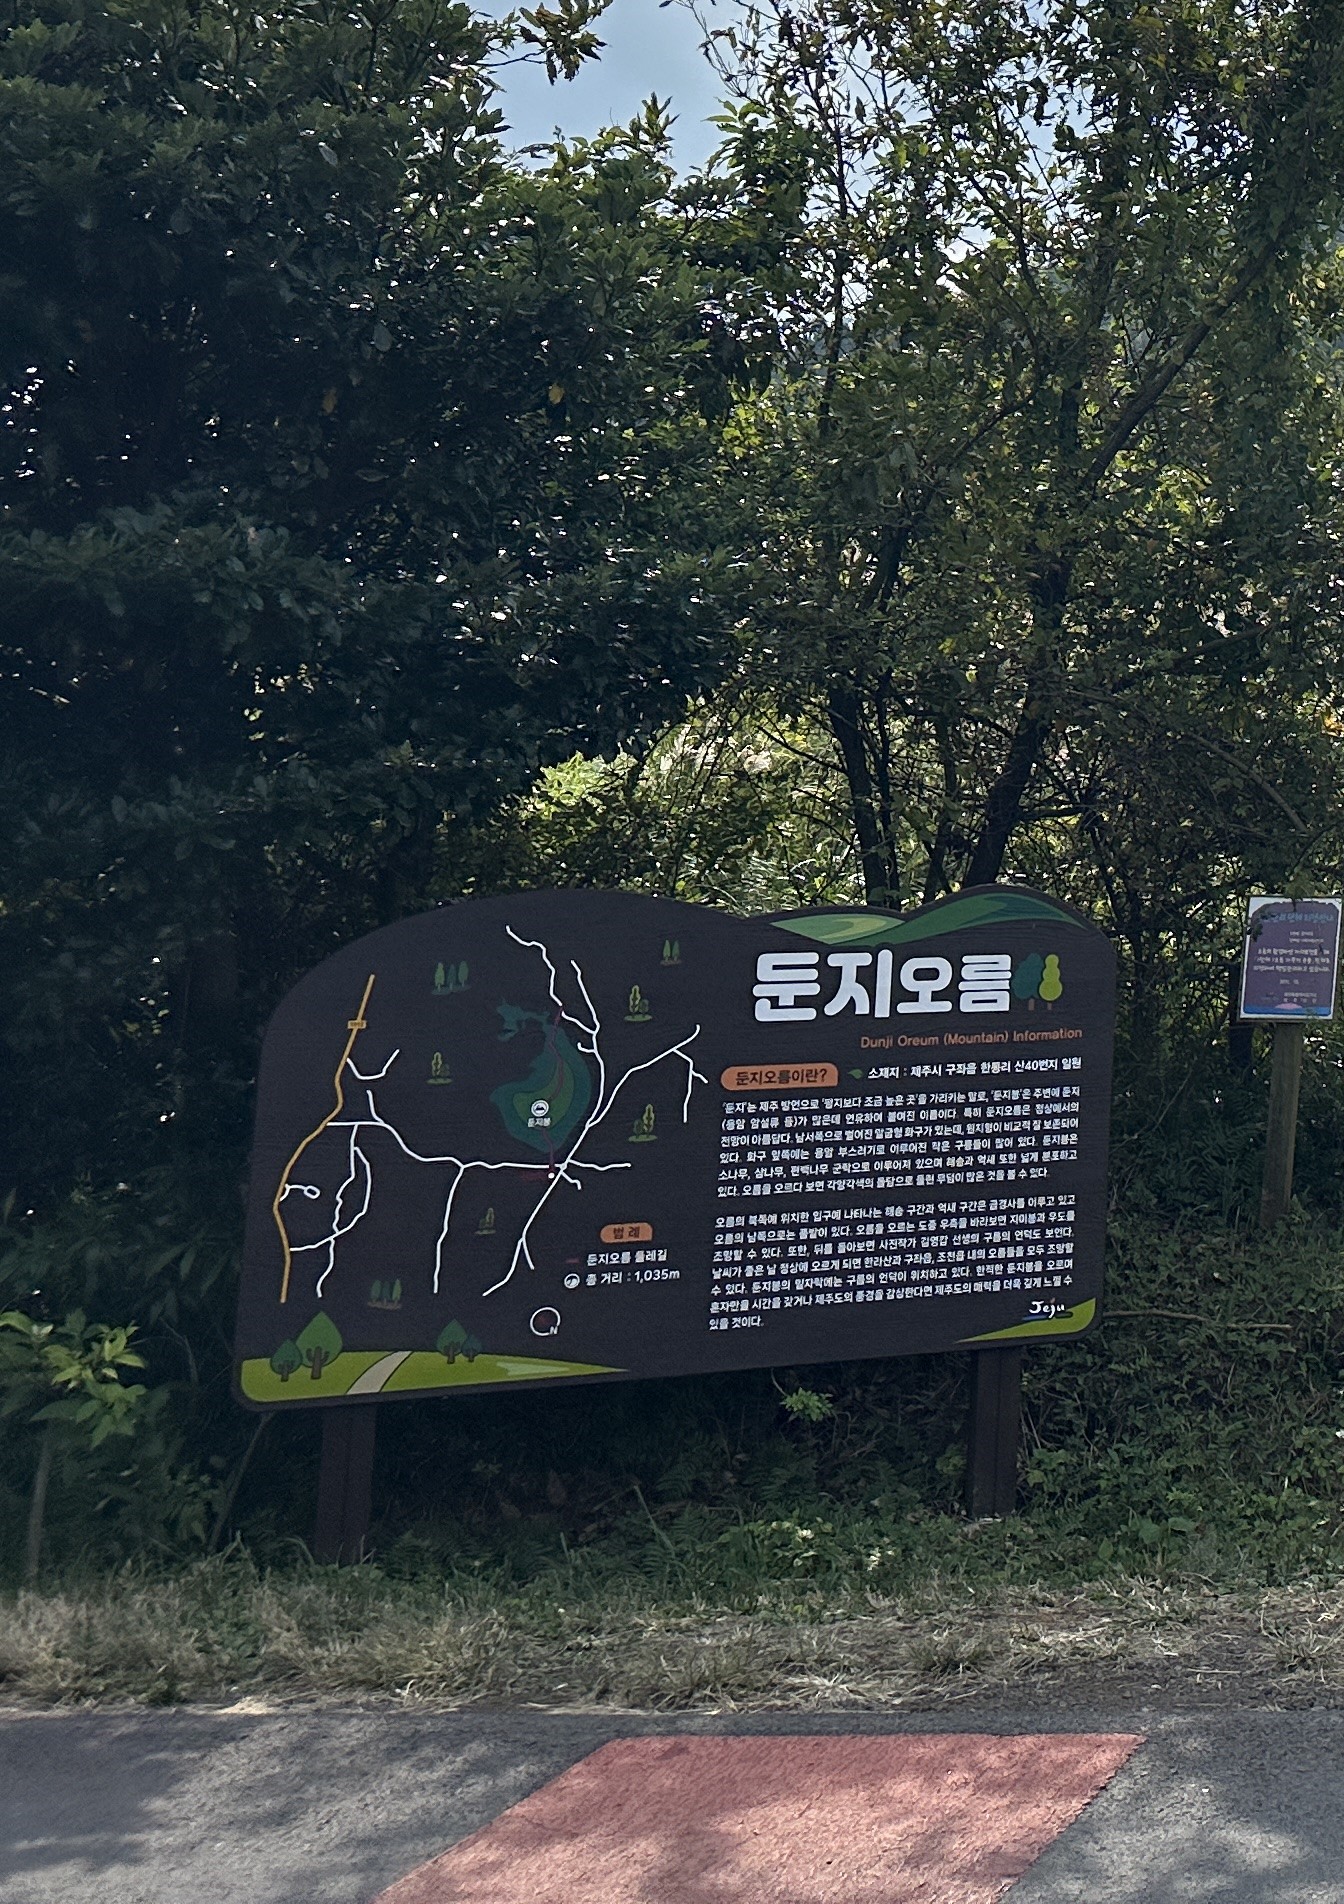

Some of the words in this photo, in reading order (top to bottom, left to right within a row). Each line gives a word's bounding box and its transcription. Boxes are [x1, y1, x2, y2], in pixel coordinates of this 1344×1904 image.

[752, 949, 1012, 1022] 둔지오름
[860, 1036, 892, 1049] Dunji
[898, 1034, 939, 1047] Oreum
[943, 1030, 1009, 1046] (Mountain)
[1013, 1028, 1082, 1042] Information
[735, 1068, 828, 1086] 둔지오름이란?
[868, 1067, 899, 1079] 소재지
[910, 1064, 942, 1078] 제주시
[587, 1251, 631, 1266] 둔지오름
[601, 1272, 622, 1284] 거리
[634, 1269, 680, 1284] 1,035m
[1029, 1298, 1065, 1318] Jeju
